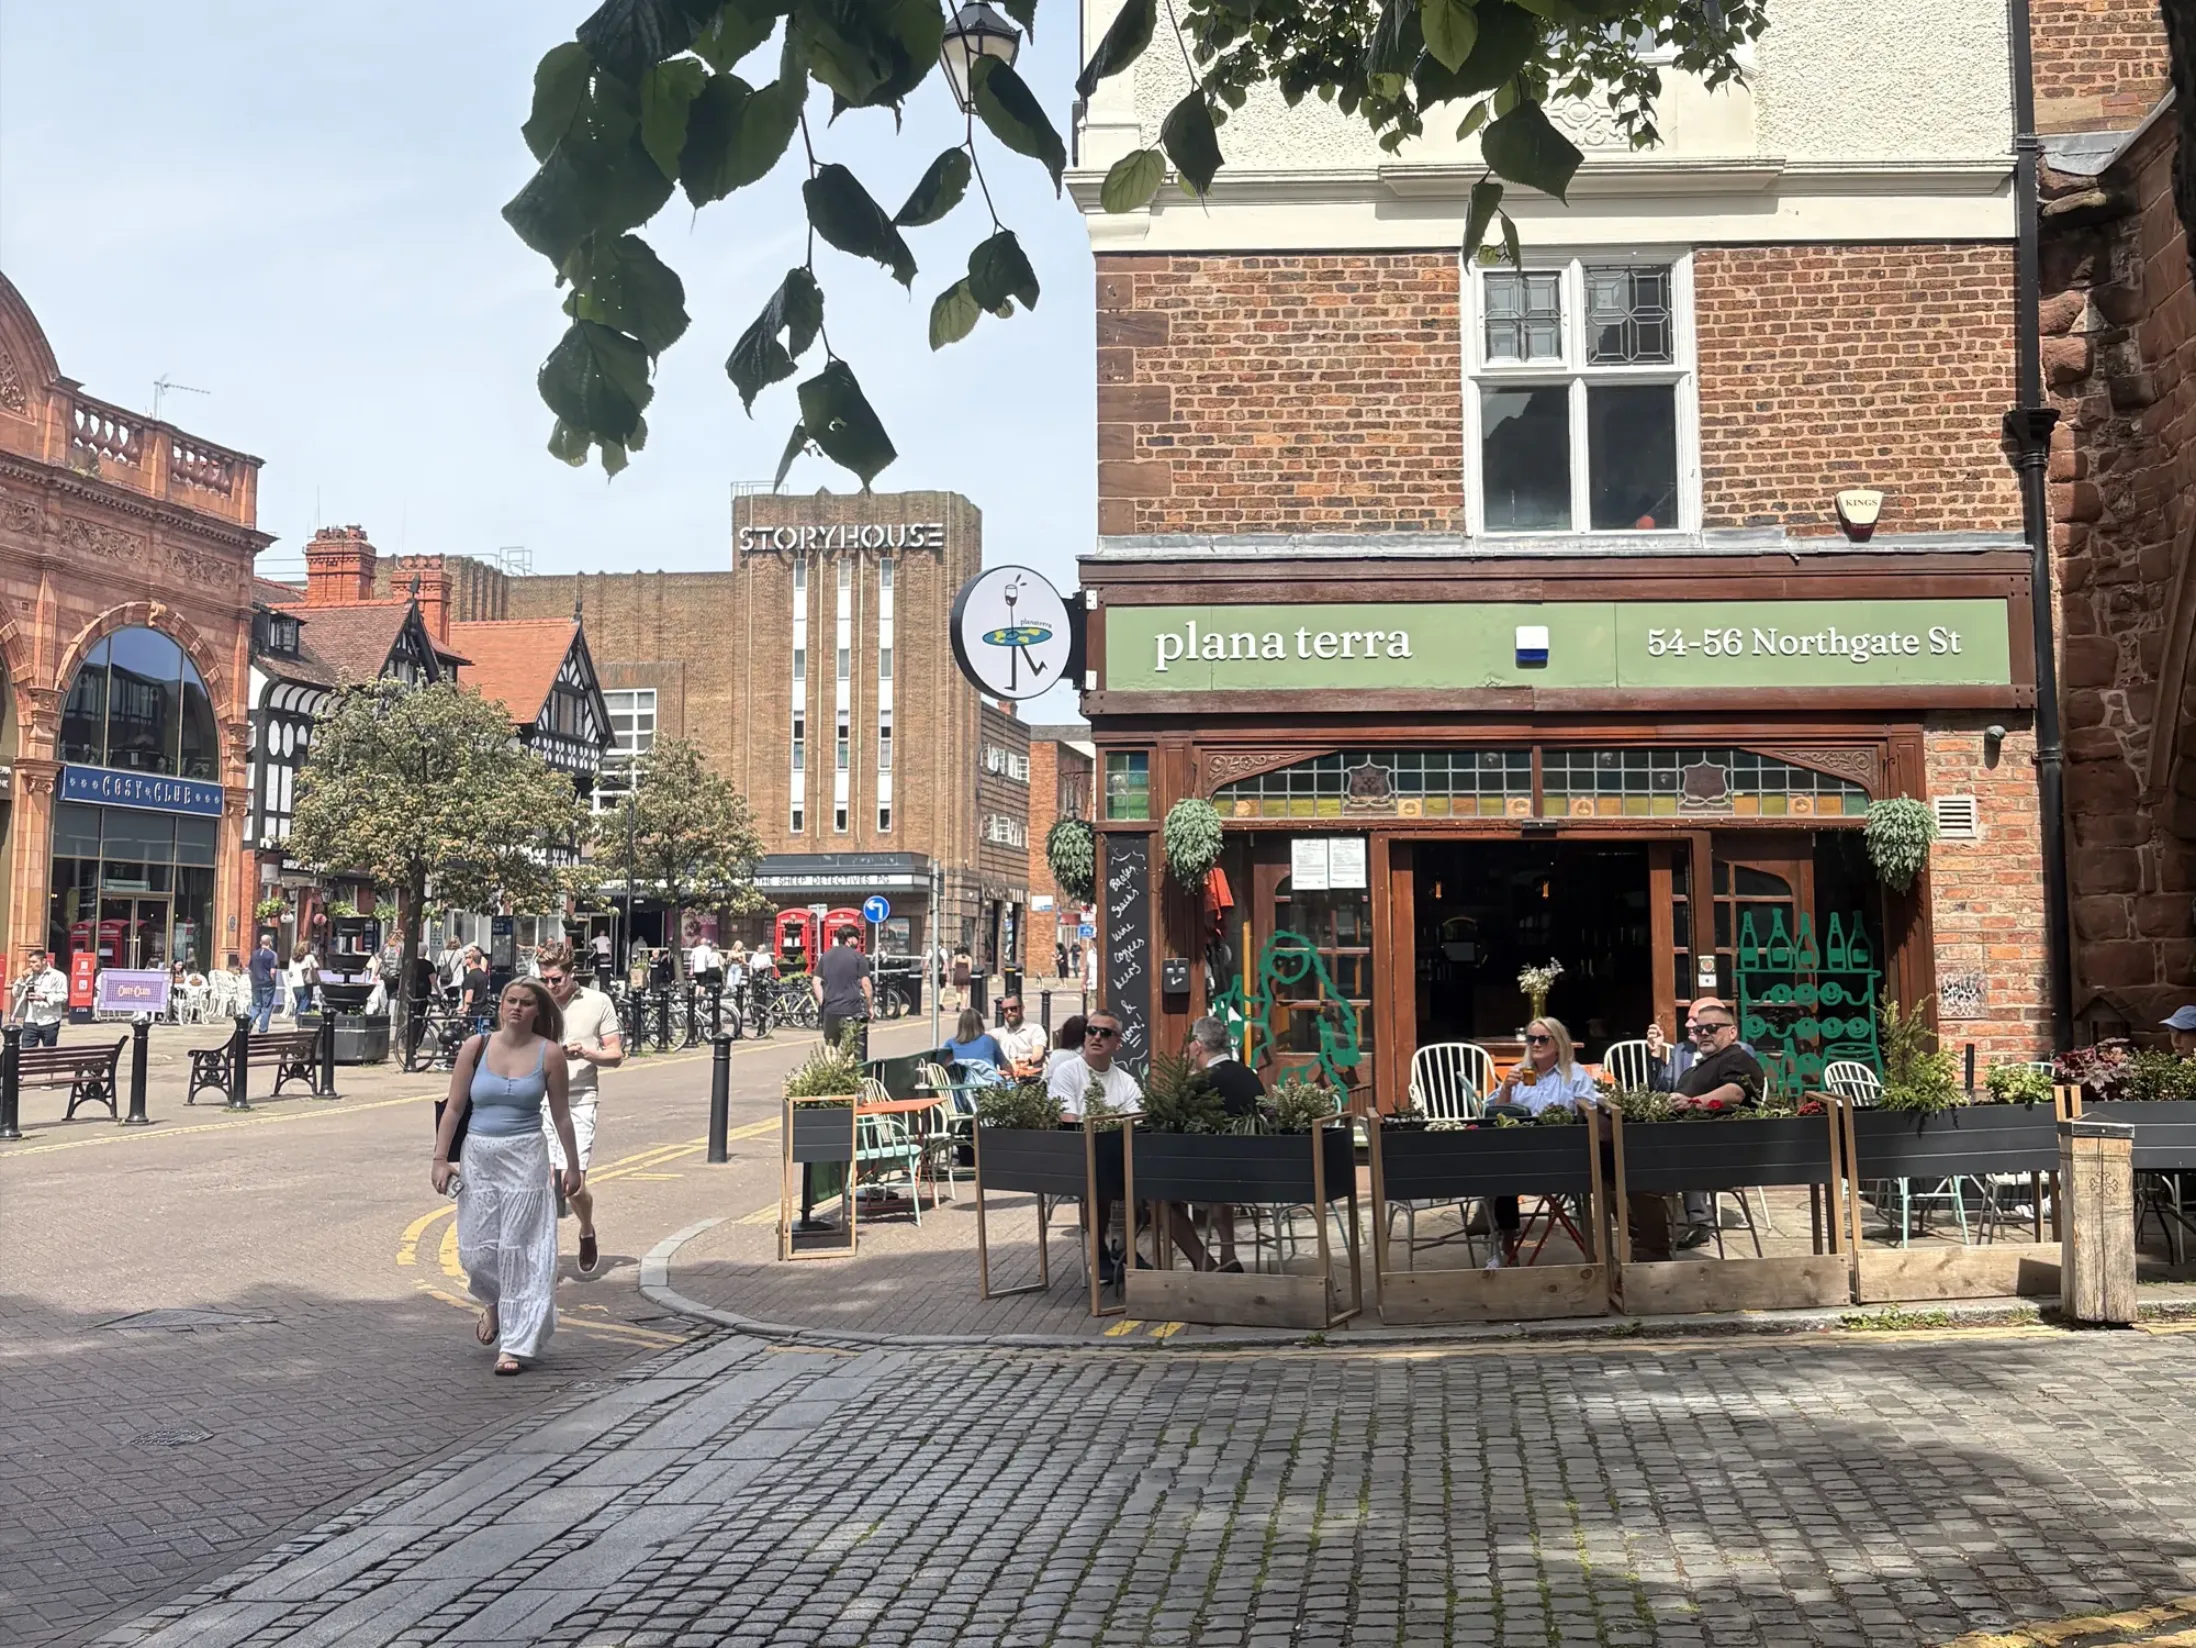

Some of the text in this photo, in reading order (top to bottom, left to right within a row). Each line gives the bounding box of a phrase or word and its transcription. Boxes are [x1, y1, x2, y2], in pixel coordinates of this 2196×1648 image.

[739, 523, 943, 550] STORYHOUSE
[1154, 620, 1413, 672] plana terra
[1647, 626, 1962, 663] 54-56 Northgate St
[102, 775, 191, 805] COSY CLUB
[758, 875, 890, 887] THE SHEEP DETECTIVES PG
